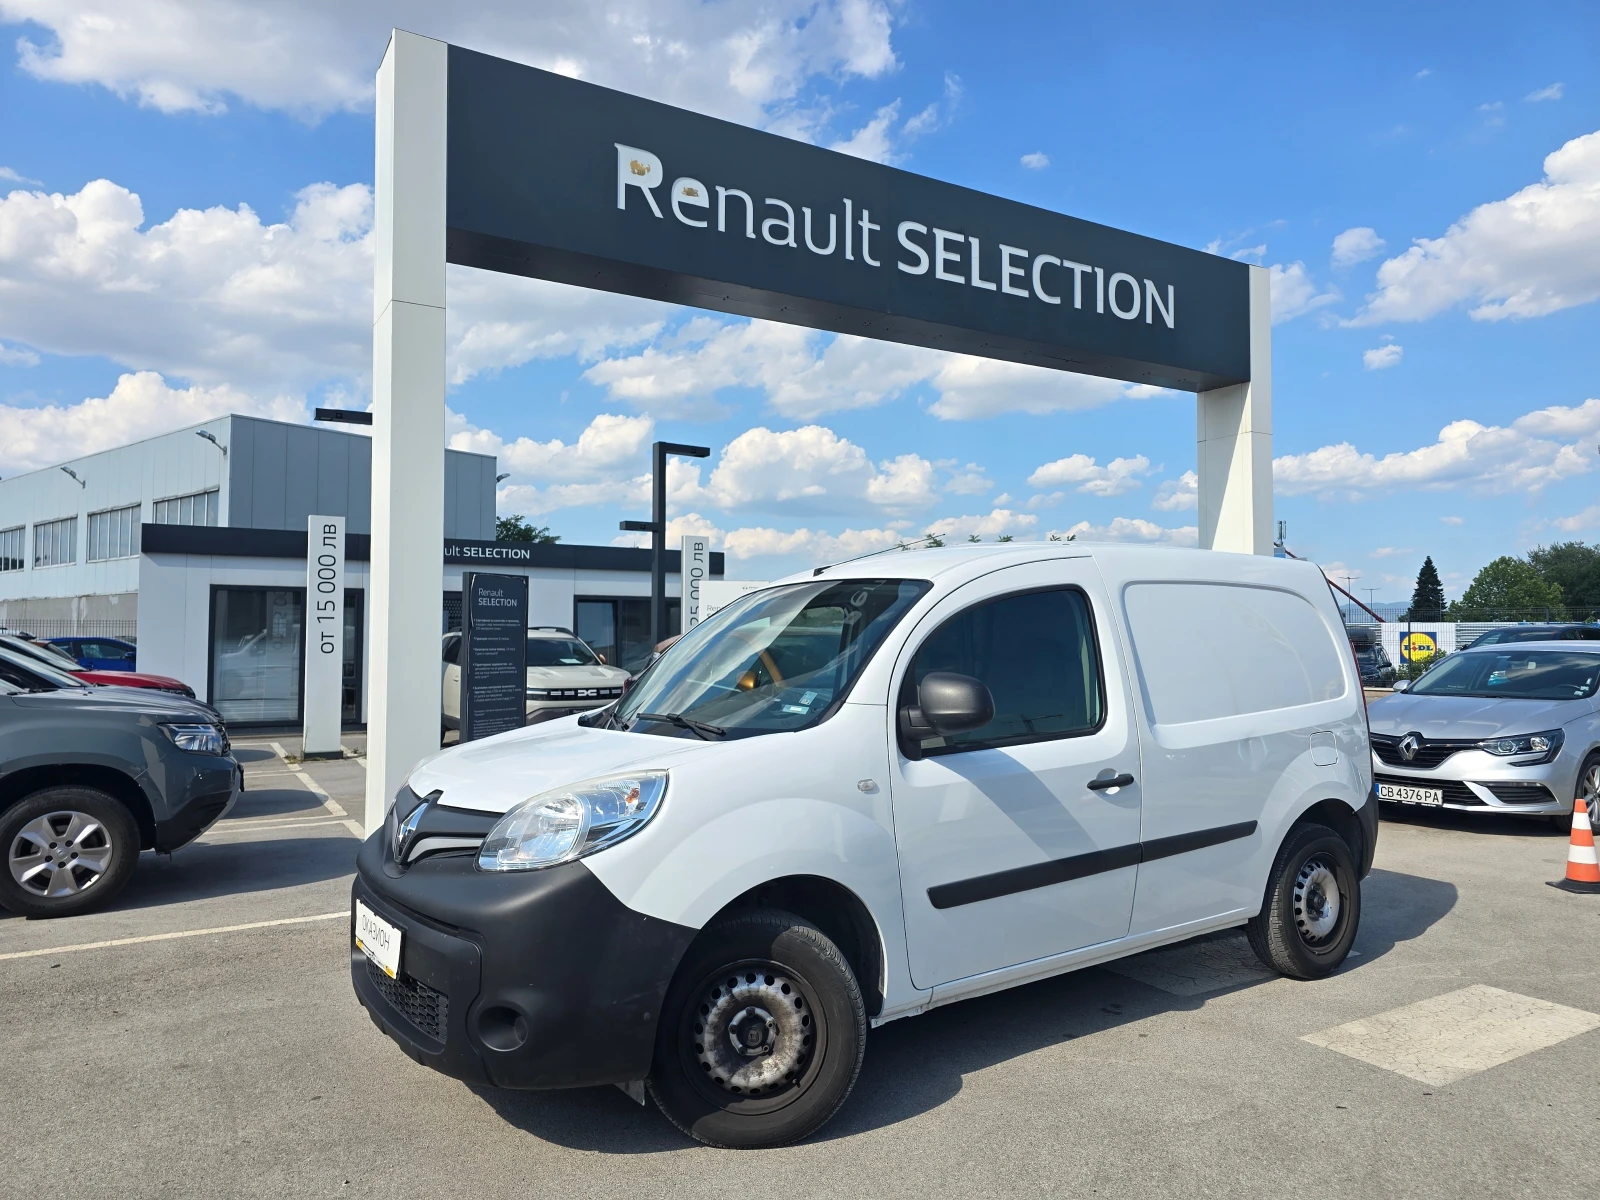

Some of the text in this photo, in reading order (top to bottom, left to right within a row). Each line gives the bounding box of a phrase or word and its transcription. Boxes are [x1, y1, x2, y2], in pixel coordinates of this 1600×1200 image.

[613, 142, 1175, 329] Renault SELECTION
[463, 547, 530, 560] SELECTION
[317, 554, 336, 594] 000
[478, 587, 504, 597] Renault
[478, 597, 518, 607] SELECTION
[316, 600, 336, 624] 15
[1380, 786, 1440, 803] CB 4376 PA
